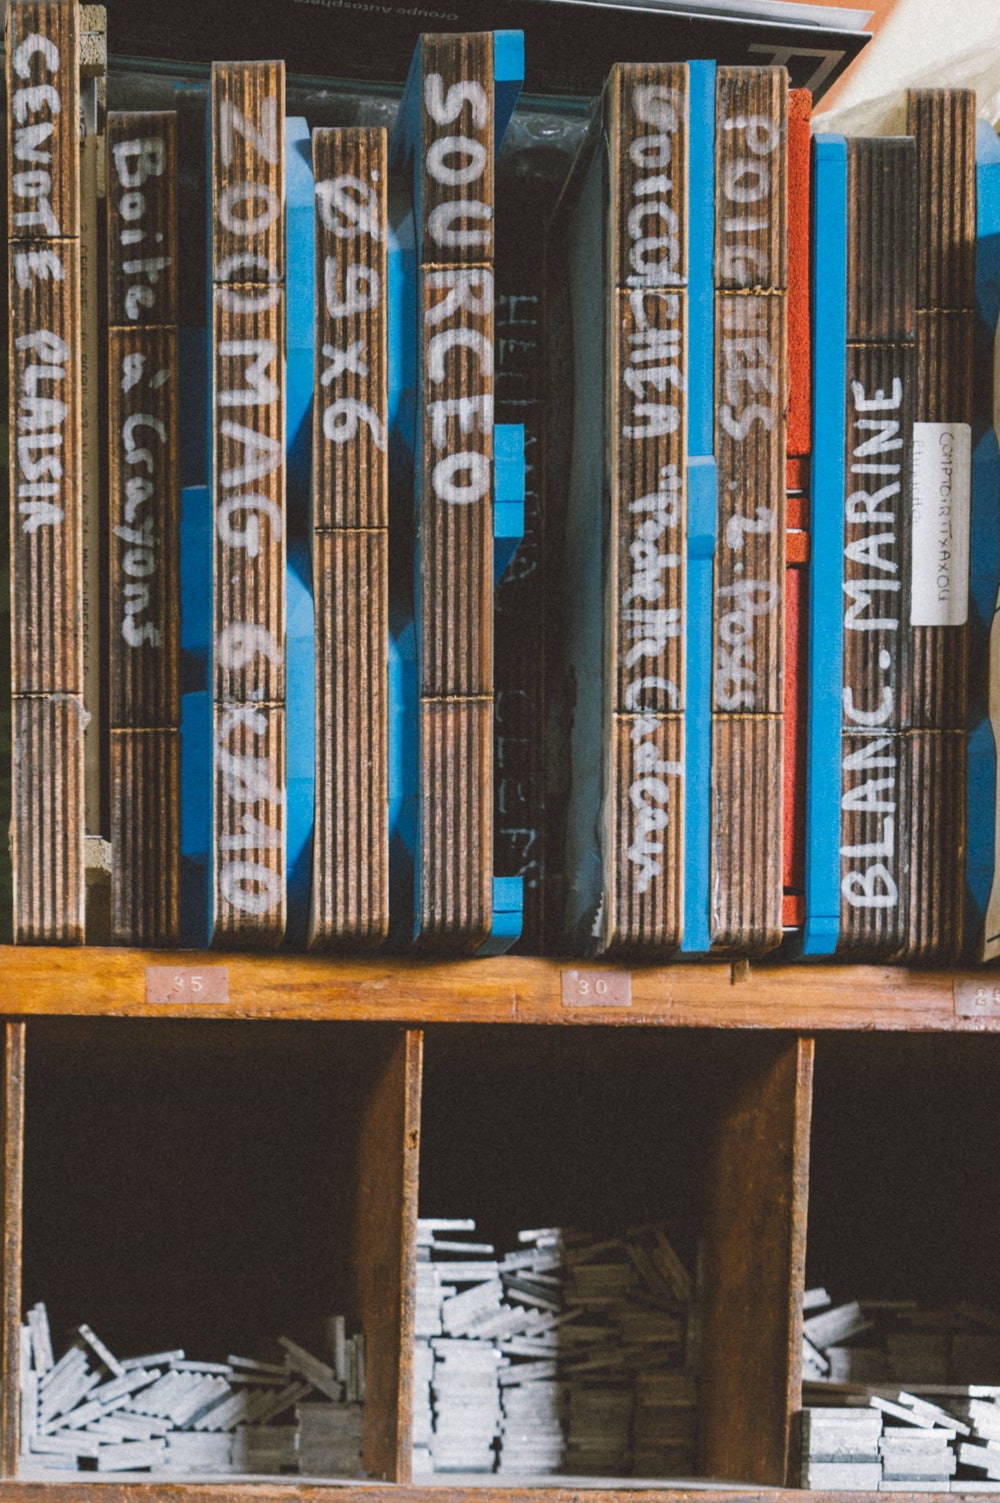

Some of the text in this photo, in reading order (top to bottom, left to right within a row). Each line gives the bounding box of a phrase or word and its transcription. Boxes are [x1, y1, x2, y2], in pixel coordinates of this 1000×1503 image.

[12, 33, 69, 535] CENOTE PLAISIR
[719, 112, 780, 441] POIGNEES
[112, 410, 166, 650] Crayons
[843, 376, 902, 631] MARINE
[171, 974, 205, 994] 35
[577, 978, 609, 996] 30
